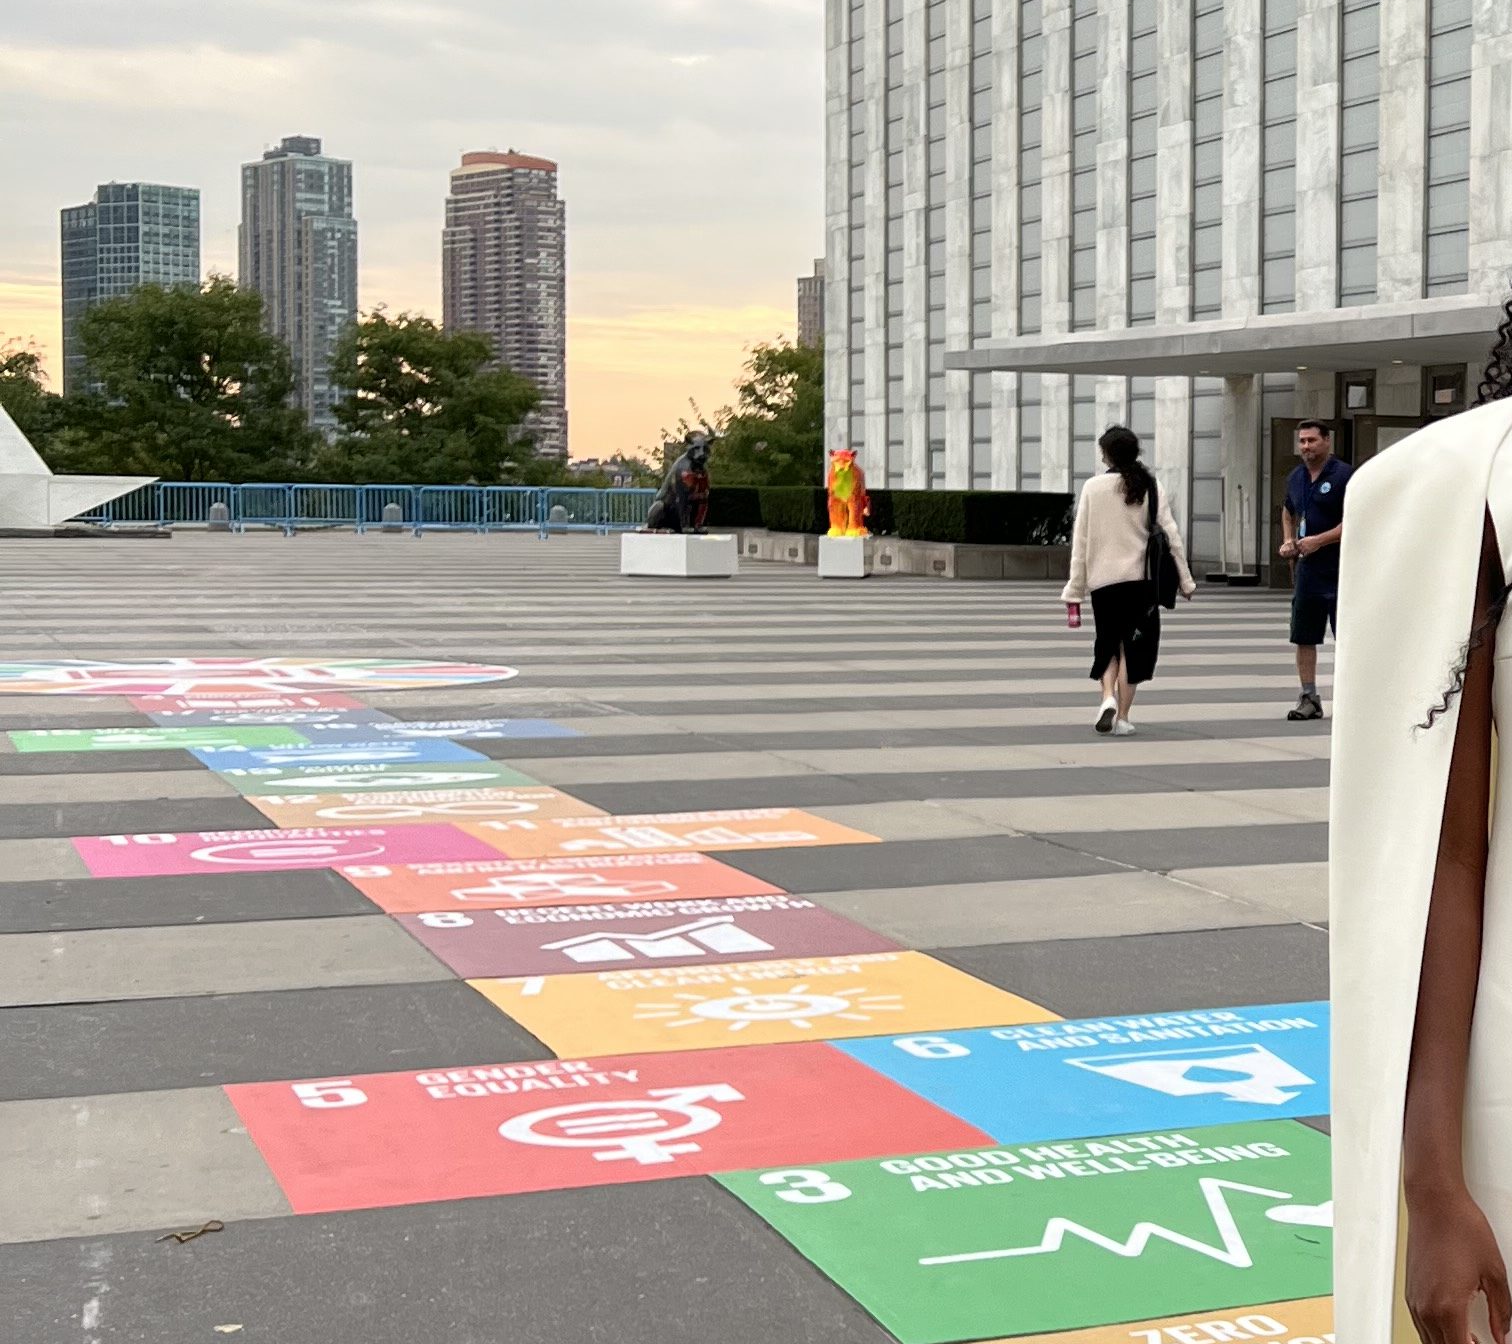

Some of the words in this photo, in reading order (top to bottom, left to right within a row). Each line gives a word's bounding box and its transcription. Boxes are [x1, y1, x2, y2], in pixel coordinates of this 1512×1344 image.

[256, 794, 319, 805] 12
[478, 819, 538, 830] 11
[100, 833, 177, 846] 10
[342, 864, 392, 878] 9
[416, 911, 474, 928] 8
[496, 974, 544, 997] 7
[989, 1021, 1118, 1040] CLEAN
[1114, 1011, 1246, 1031] WATER
[1014, 1033, 1101, 1051] AND
[1099, 1017, 1319, 1045] SANITATION
[892, 1036, 972, 1059] 6
[415, 1061, 594, 1086] GENDER
[426, 1069, 640, 1099] EQUALITY
[290, 1079, 369, 1109] 5
[879, 1151, 1022, 1175] GOOD
[1019, 1133, 1200, 1162] HEALTH
[909, 1168, 1015, 1192] AND
[1012, 1141, 1291, 1180] WELL-BEING
[757, 1169, 852, 1204] 3
